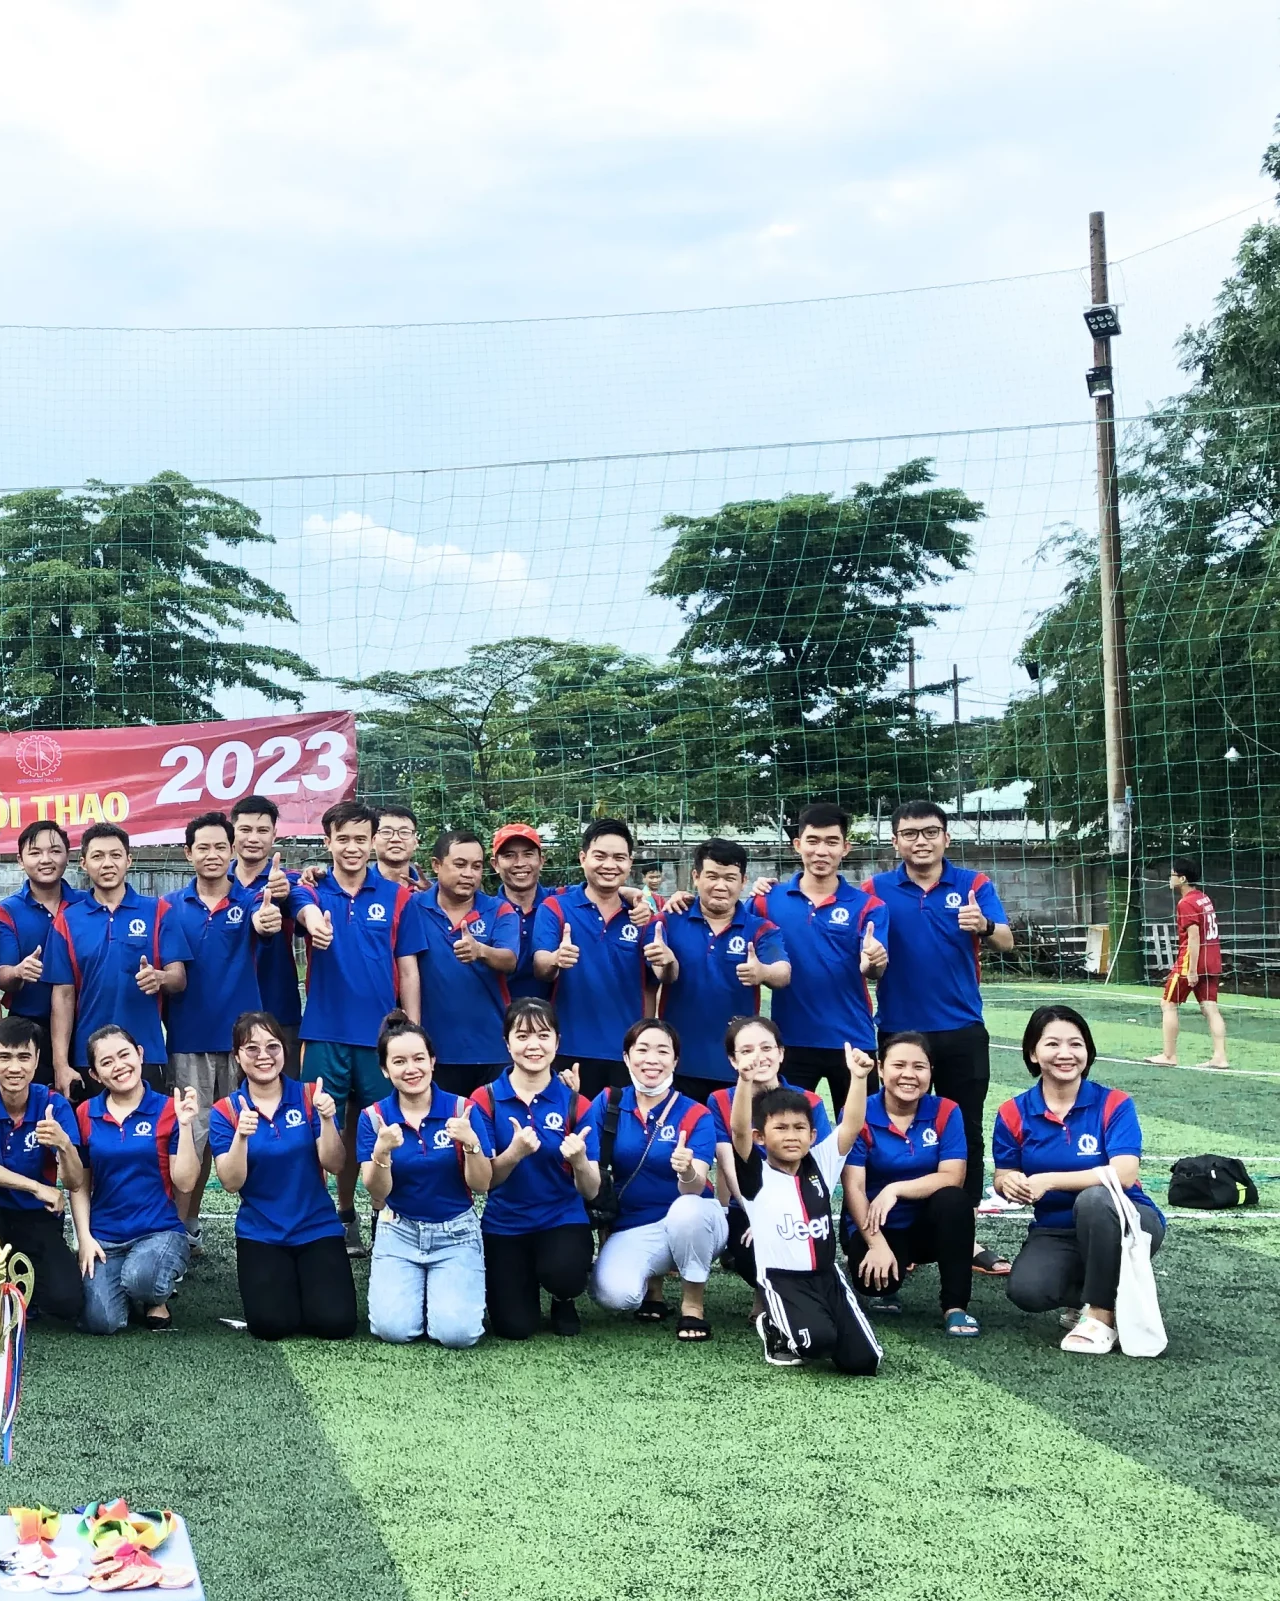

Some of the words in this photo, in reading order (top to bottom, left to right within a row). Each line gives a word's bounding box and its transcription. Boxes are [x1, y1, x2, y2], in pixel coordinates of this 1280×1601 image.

[156, 730, 348, 805] 2023
[30, 791, 130, 827] THAO
[776, 1213, 830, 1241] Jeep
